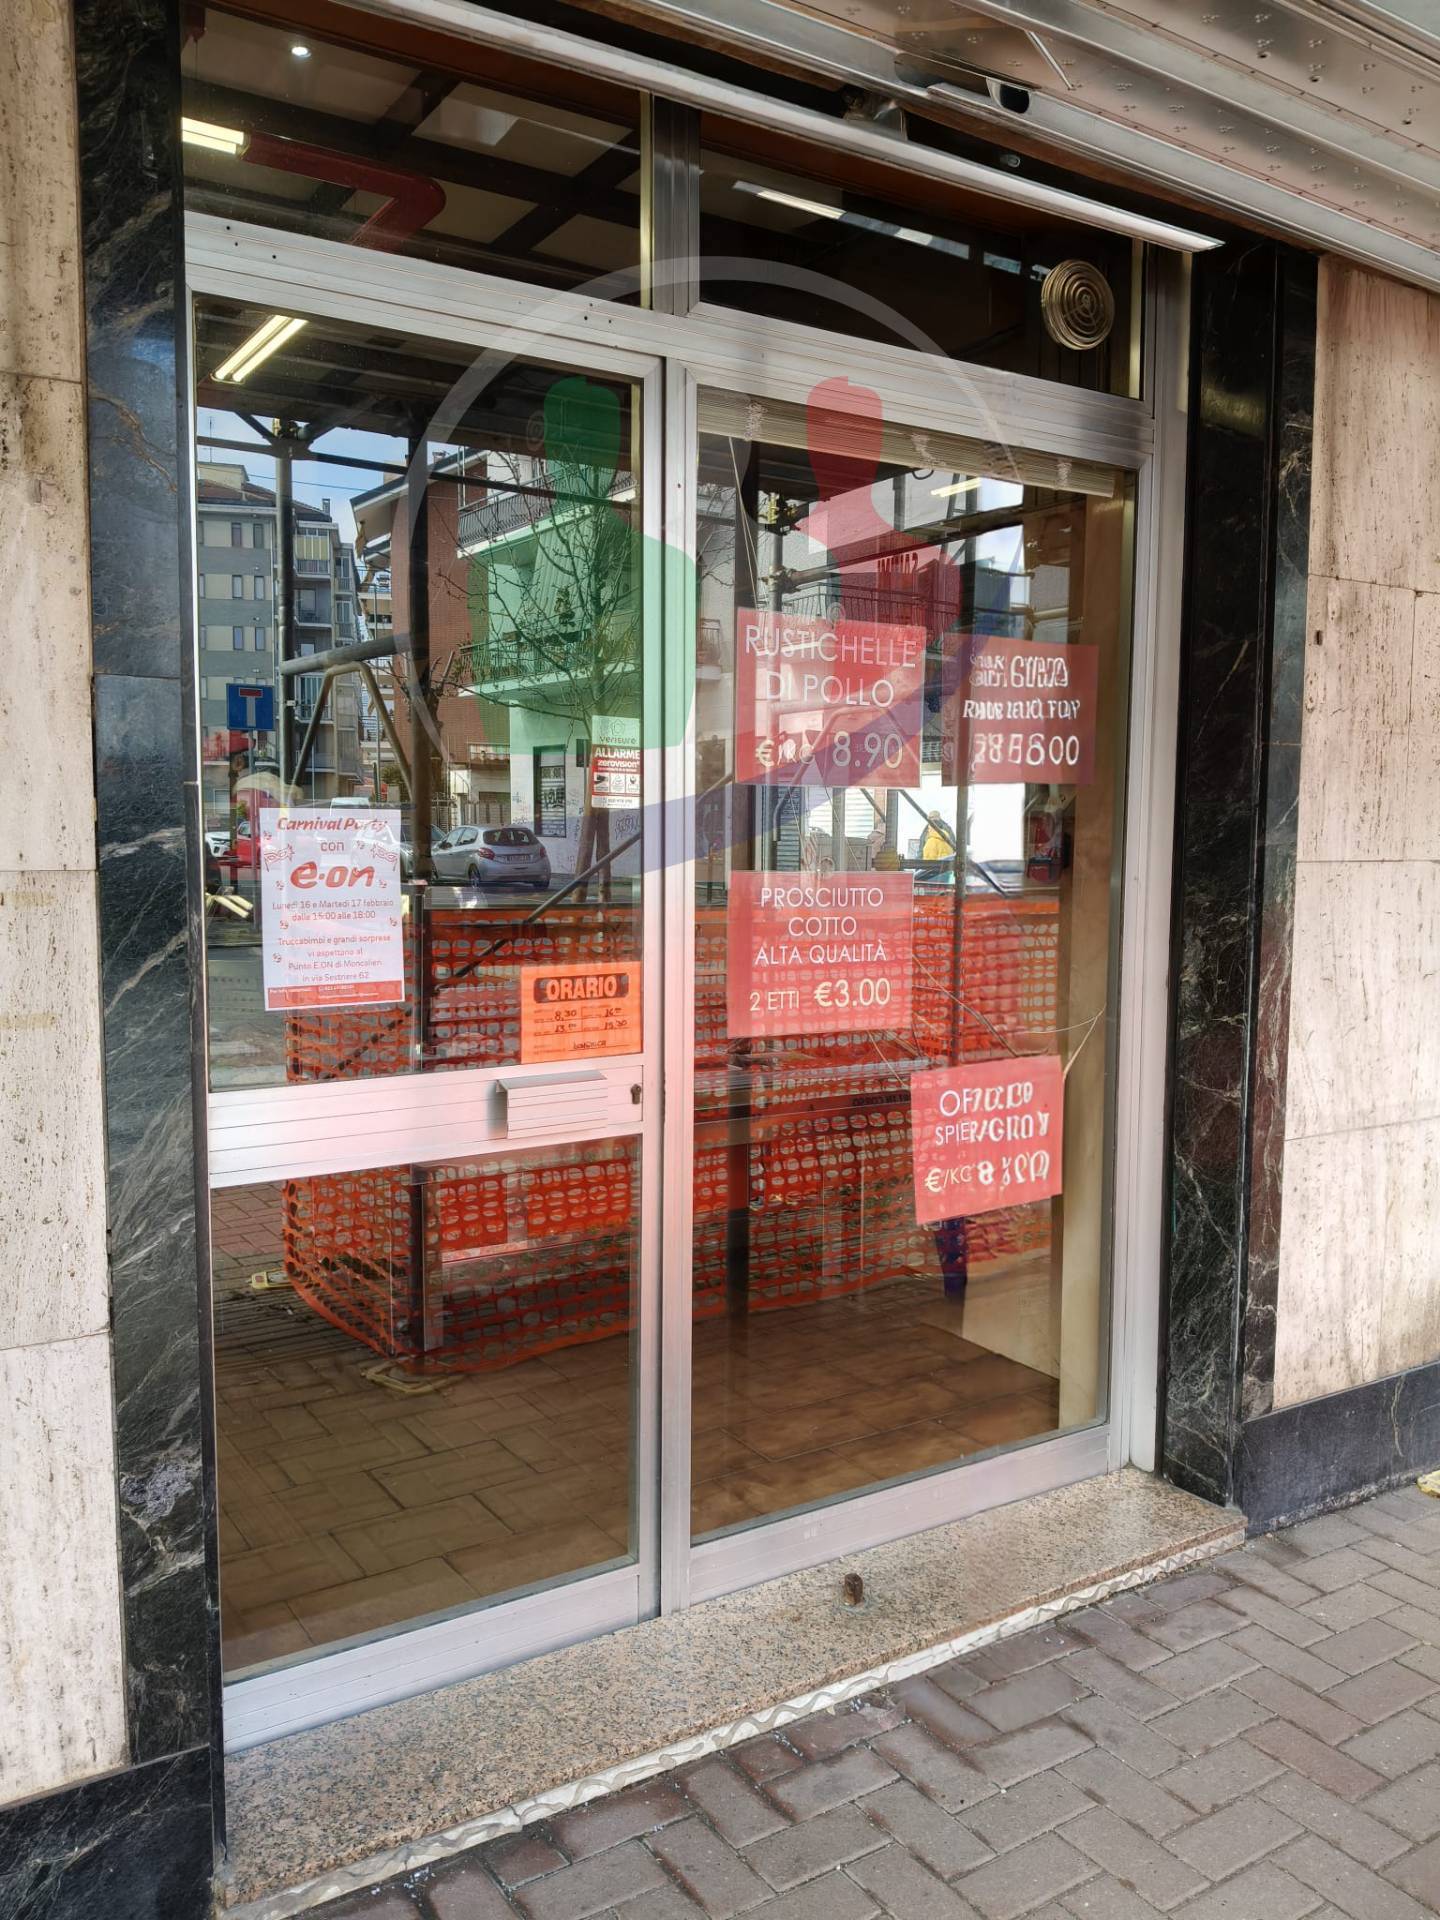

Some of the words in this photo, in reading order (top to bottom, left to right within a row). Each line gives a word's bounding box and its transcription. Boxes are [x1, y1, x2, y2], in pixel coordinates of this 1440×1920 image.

[745, 624, 917, 668] RUSTICHELLE
[766, 671, 792, 700] DI
[804, 674, 894, 708] POLLO
[595, 747, 640, 759] ALLARME
[832, 731, 903, 769] 8.90
[277, 816, 343, 831] Carnival
[320, 841, 345, 852] con
[351, 899, 362, 907] 17
[363, 898, 394, 907] febbraio
[761, 887, 884, 907] PROSCIUTTO
[788, 916, 857, 937] COTTO
[333, 935, 358, 945] grandi
[359, 934, 391, 945] sorprese
[754, 946, 802, 965] ALTA
[809, 939, 887, 964] QUALITÀ
[546, 975, 617, 1000] ORARIO
[750, 992, 761, 1011] 2
[767, 990, 799, 1011] ETTI
[814, 978, 891, 1007] €3.00
